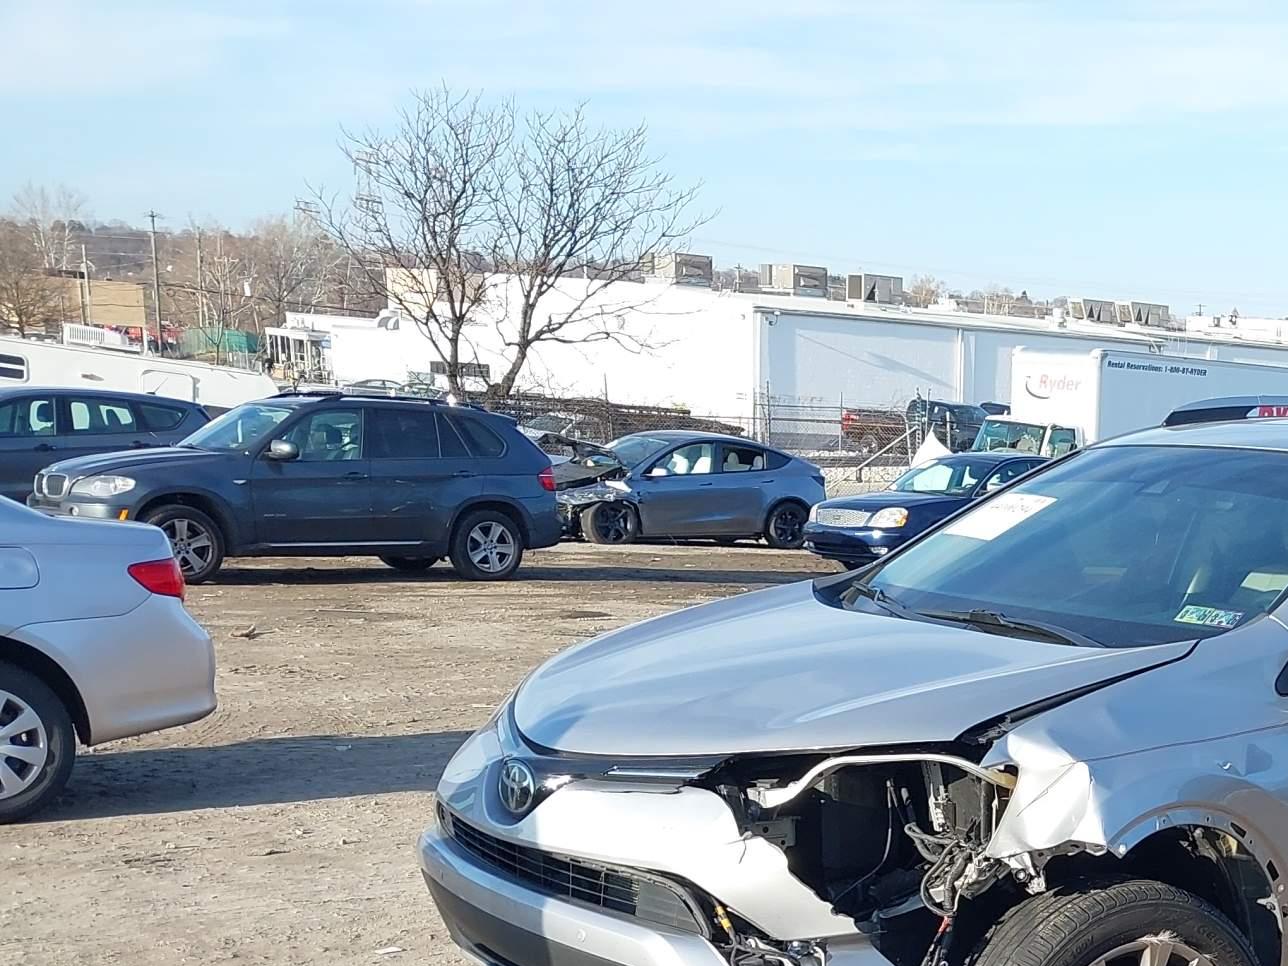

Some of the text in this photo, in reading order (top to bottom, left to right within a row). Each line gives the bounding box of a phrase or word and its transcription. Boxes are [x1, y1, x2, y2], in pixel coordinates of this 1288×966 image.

[1107, 360, 1126, 369] Rental
[1127, 362, 1164, 372] Reservations:
[1040, 374, 1082, 392] Ryder
